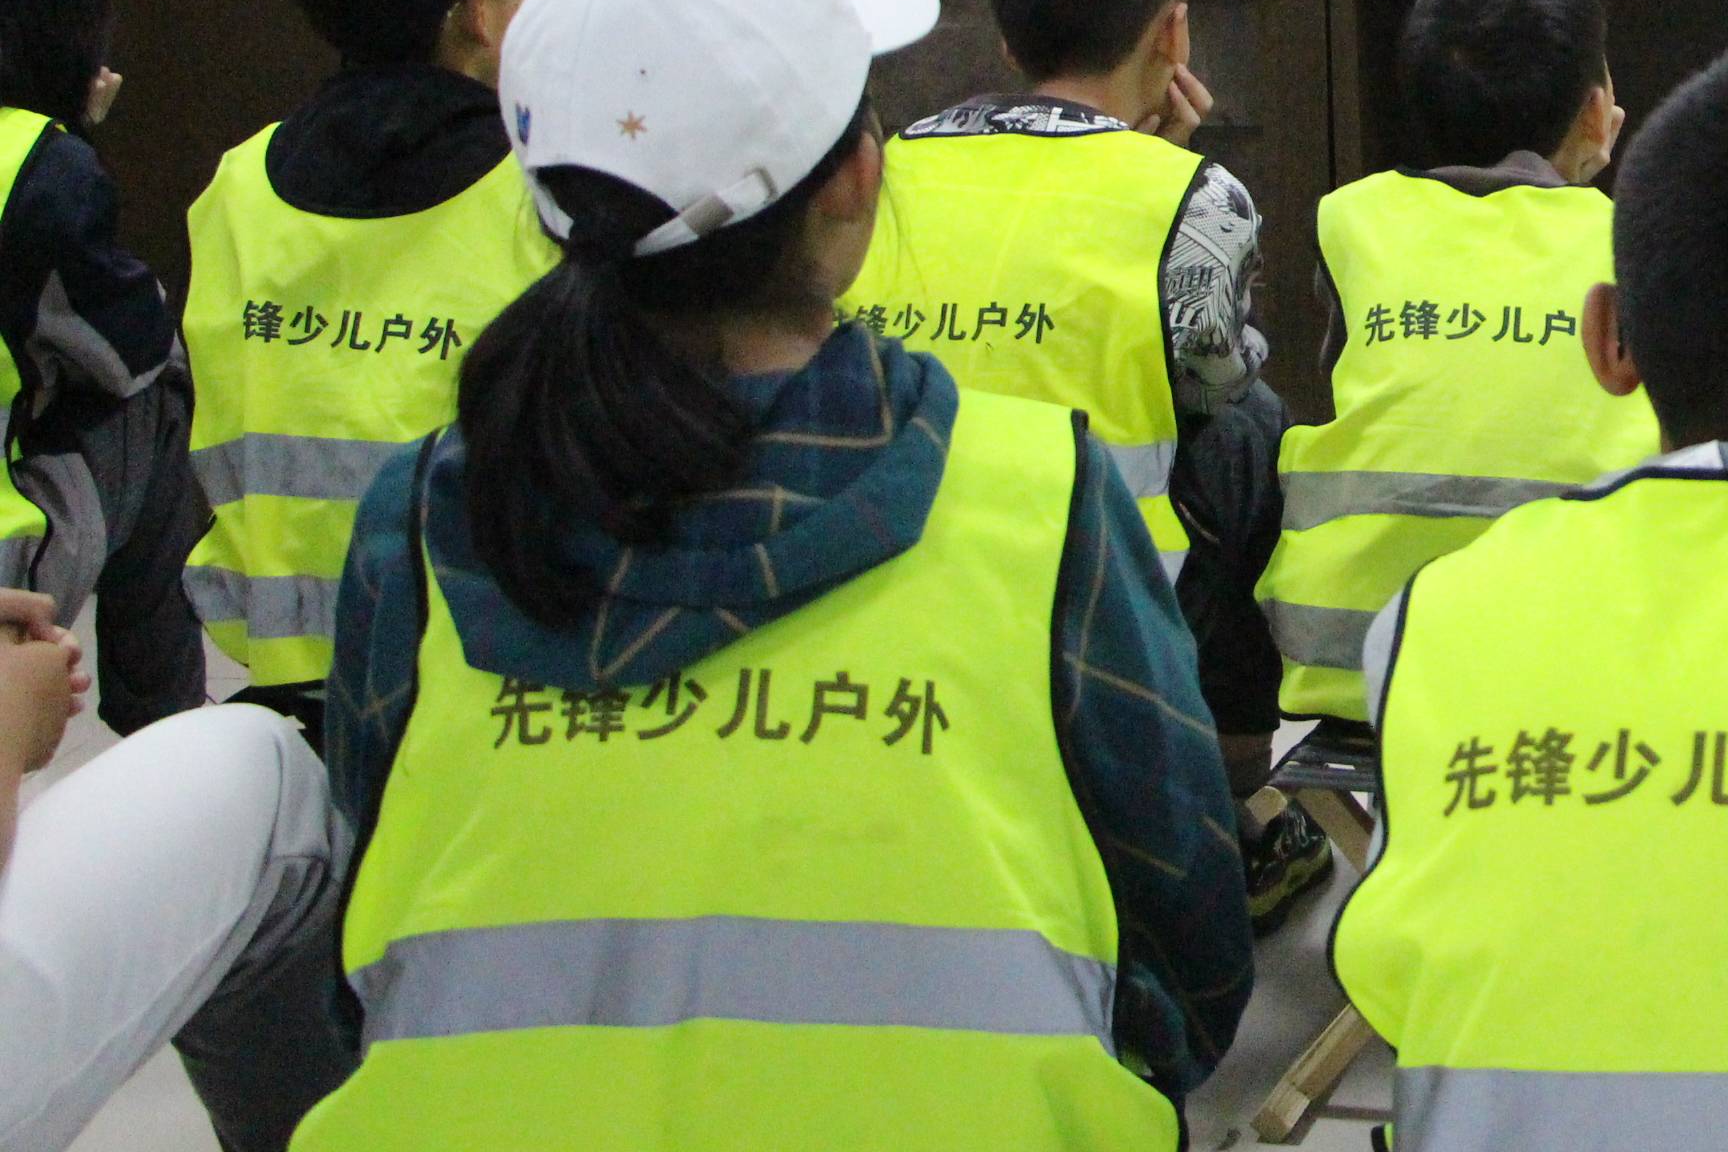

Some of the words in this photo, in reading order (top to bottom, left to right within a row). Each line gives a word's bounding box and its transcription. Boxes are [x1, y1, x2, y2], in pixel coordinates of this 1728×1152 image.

[242, 299, 463, 360] 锋少儿户外
[834, 302, 1056, 344] 锋少儿户外
[1364, 300, 1577, 347] 先锋少儿户
[490, 668, 950, 756] 先锋少儿户外
